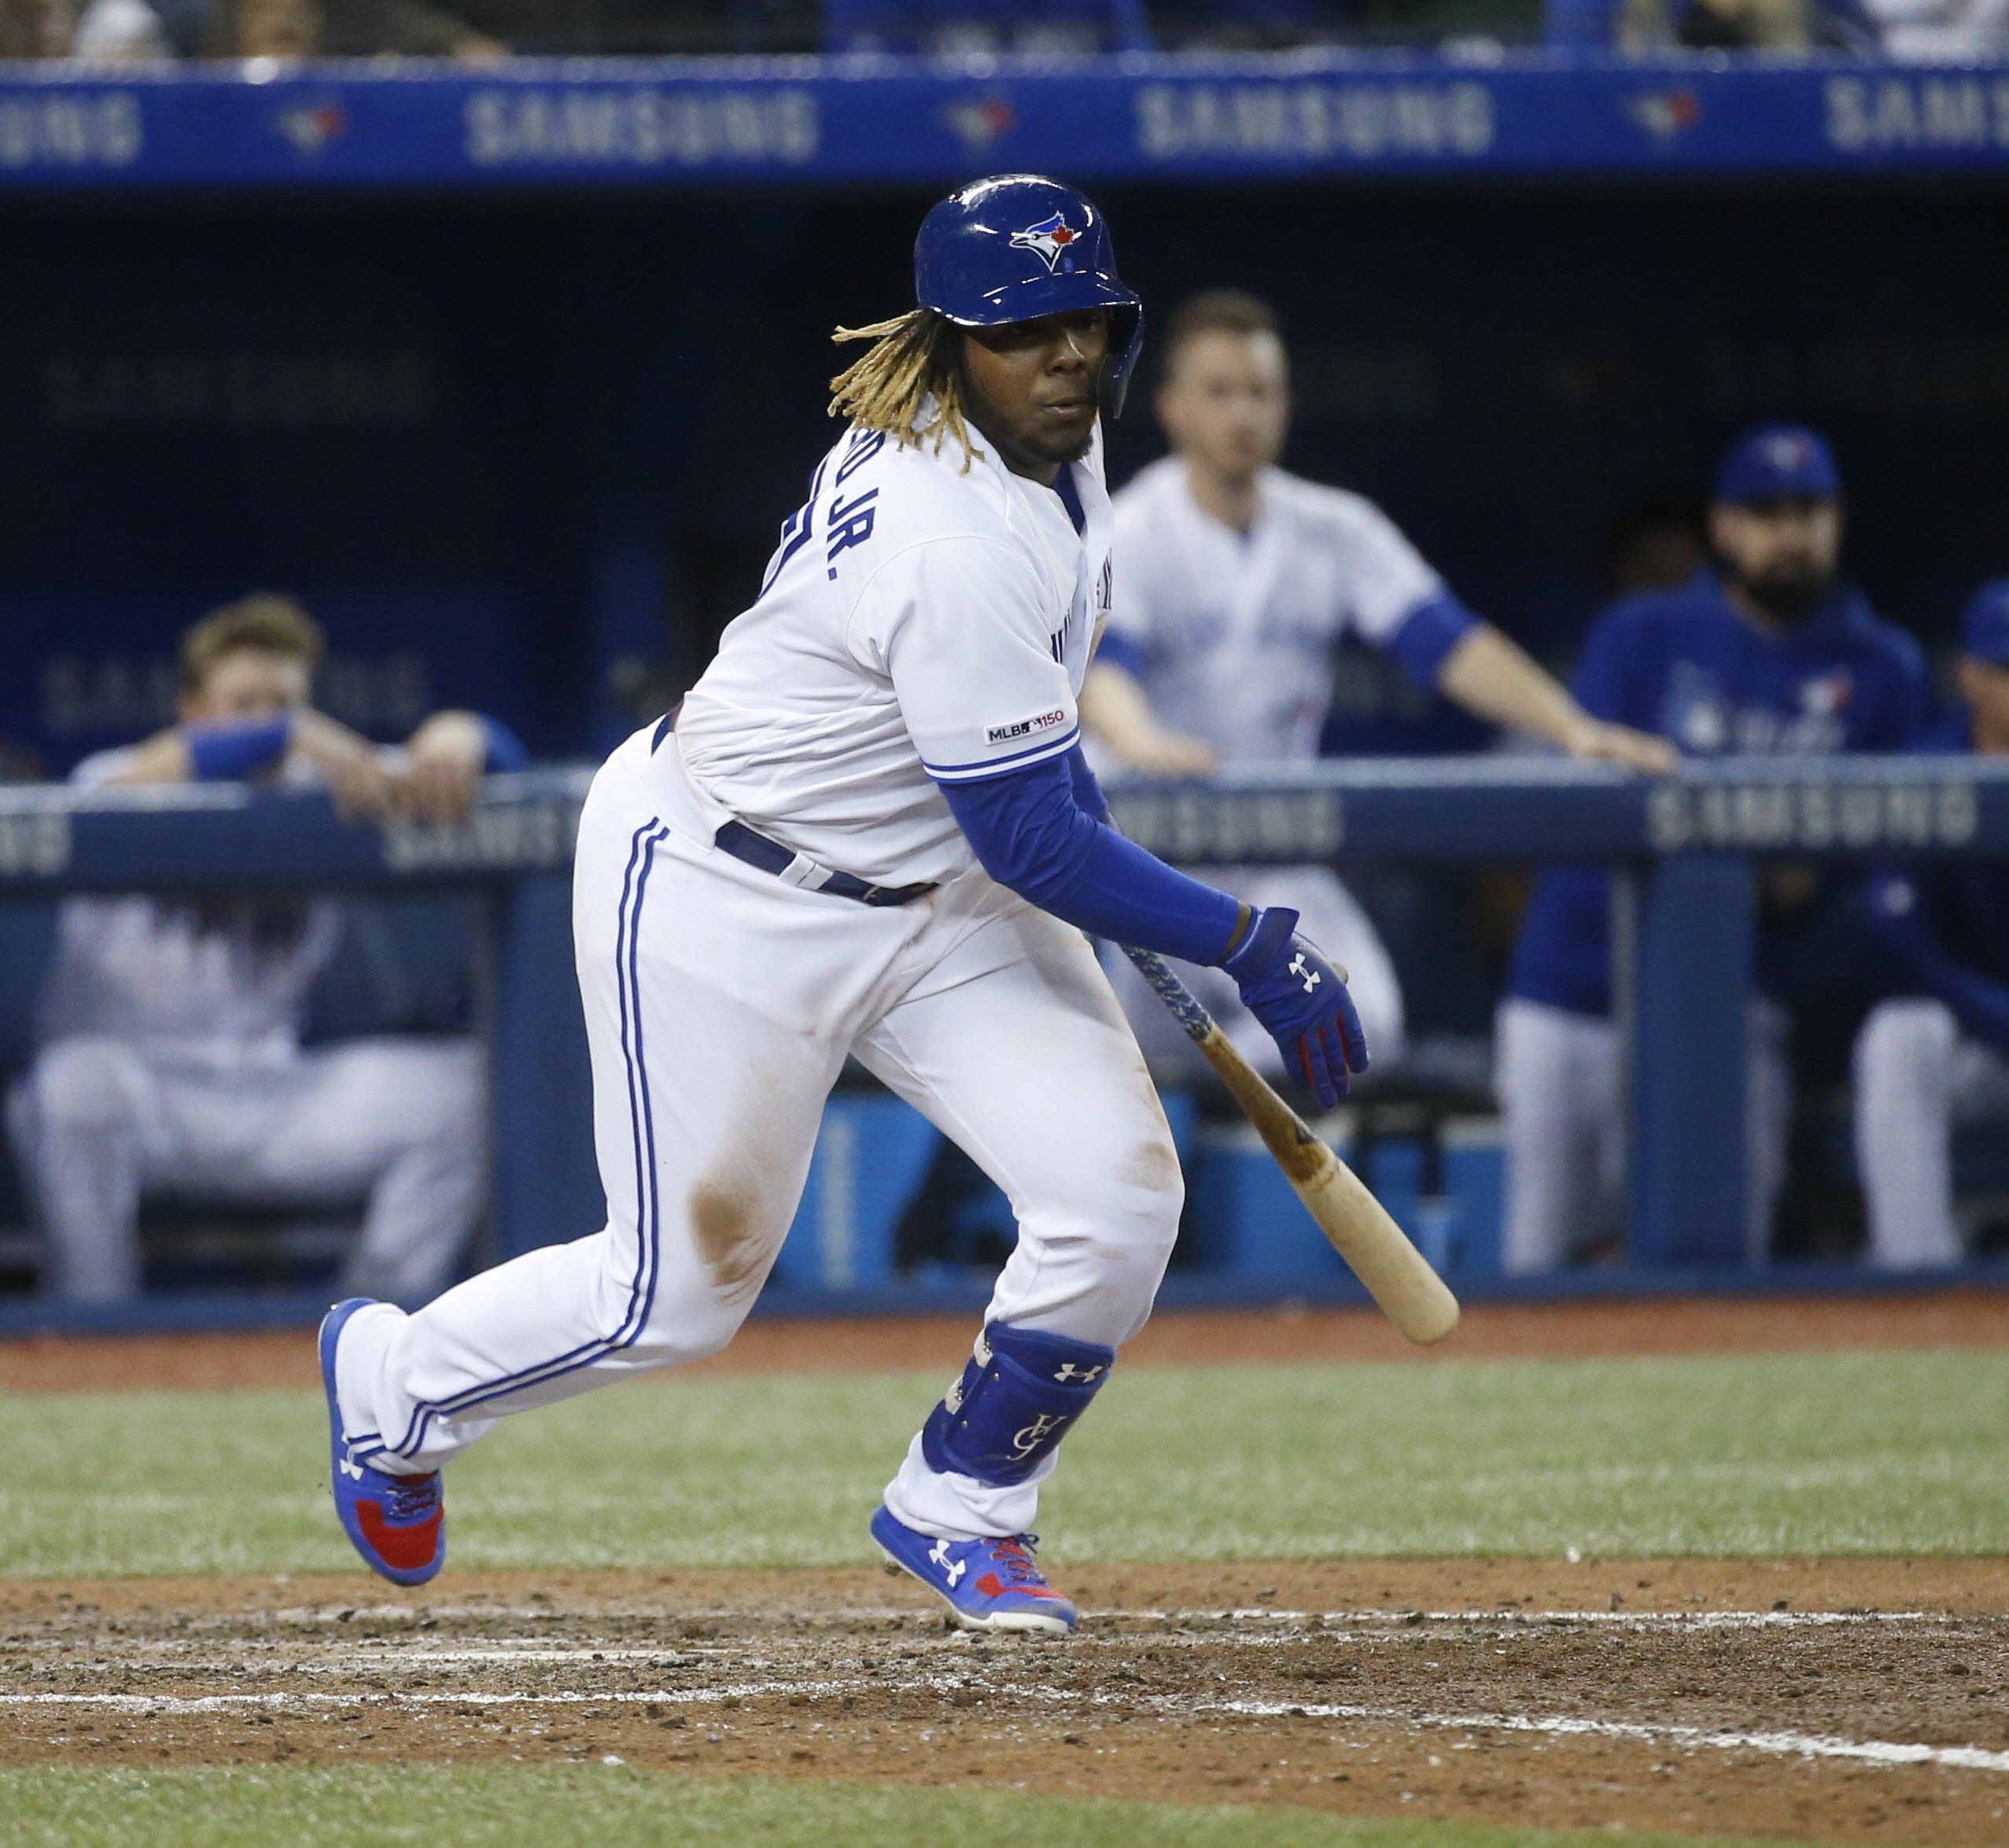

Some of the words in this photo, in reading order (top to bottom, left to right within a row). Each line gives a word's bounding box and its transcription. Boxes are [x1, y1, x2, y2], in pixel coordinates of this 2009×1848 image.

[466, 89, 820, 165] SAMSUNG
[1137, 85, 1494, 161] SAMSUNG
[827, 487, 879, 581] JR.
[989, 725, 1022, 741] MLB
[1041, 710, 1064, 727] 150
[1650, 788, 1976, 851] SAMSUNG
